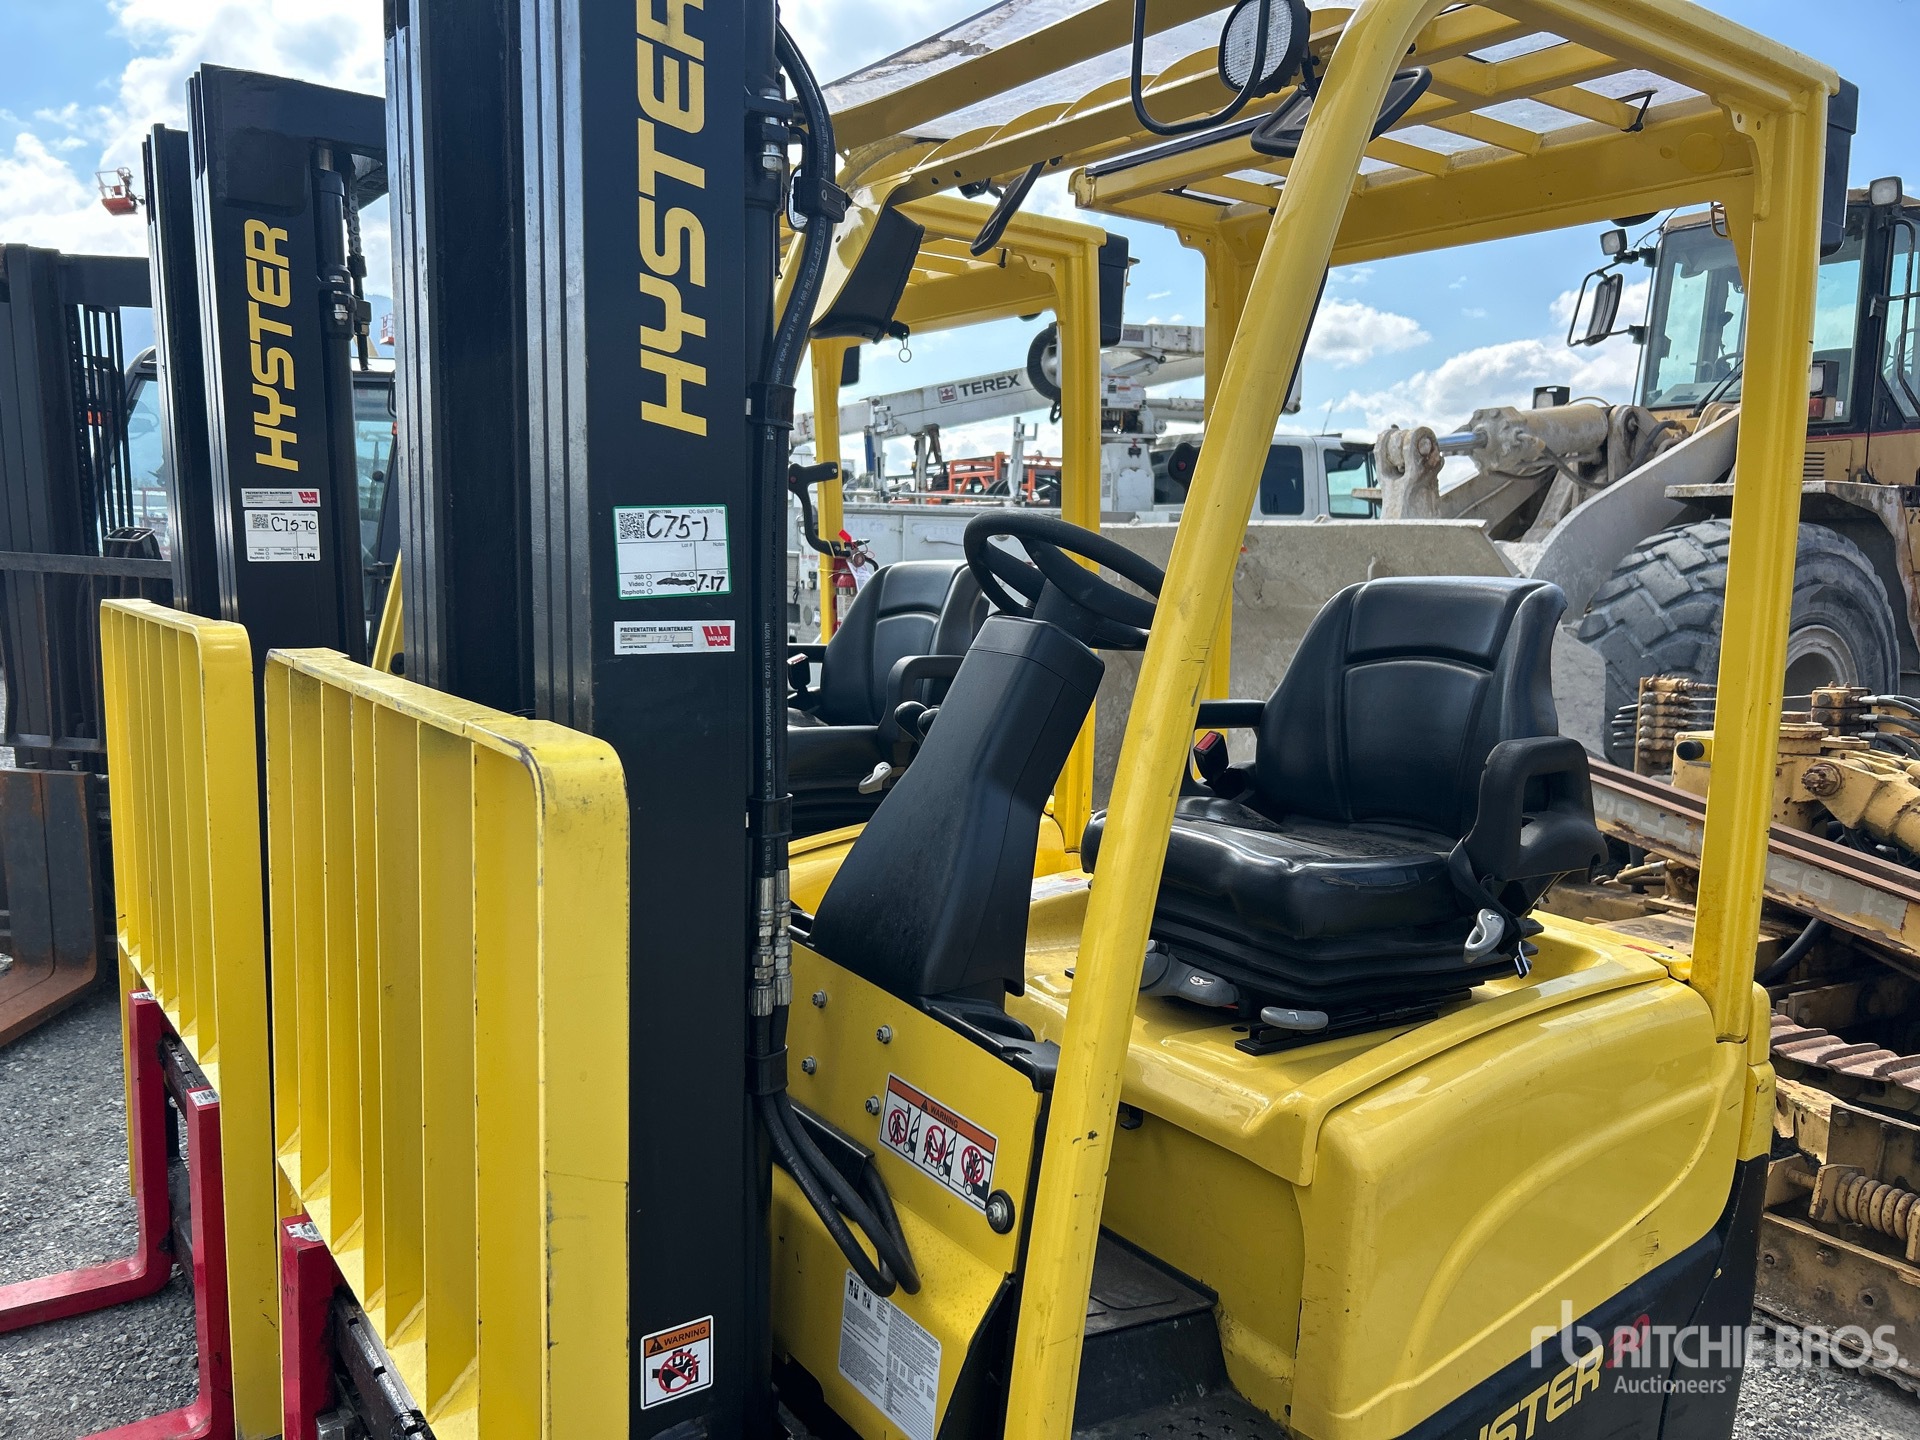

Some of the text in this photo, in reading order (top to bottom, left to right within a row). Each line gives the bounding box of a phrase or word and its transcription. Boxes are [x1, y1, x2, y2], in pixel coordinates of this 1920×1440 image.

[636, 0, 707, 437] HYSTER
[244, 218, 299, 471] HYSTER
[958, 374, 1021, 397] TEREX
[930, 1105, 959, 1129] WARNING
[664, 1326, 707, 1347] WARNING
